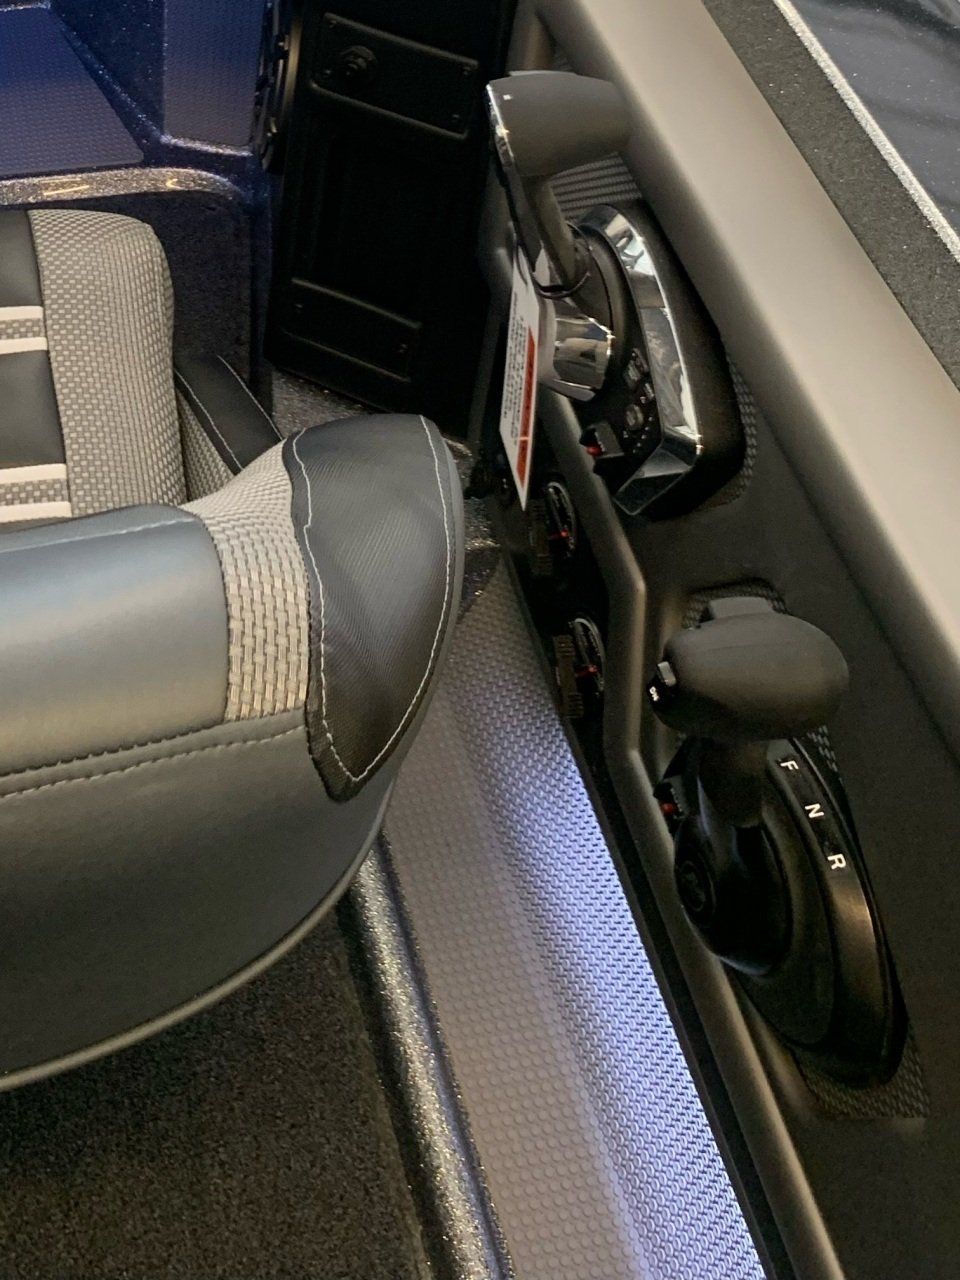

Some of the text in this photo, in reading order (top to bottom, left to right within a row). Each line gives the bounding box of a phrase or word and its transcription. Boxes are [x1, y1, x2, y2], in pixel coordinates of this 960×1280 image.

[780, 760, 800, 771] F
[804, 803, 825, 819] N
[827, 853, 847, 870] R
